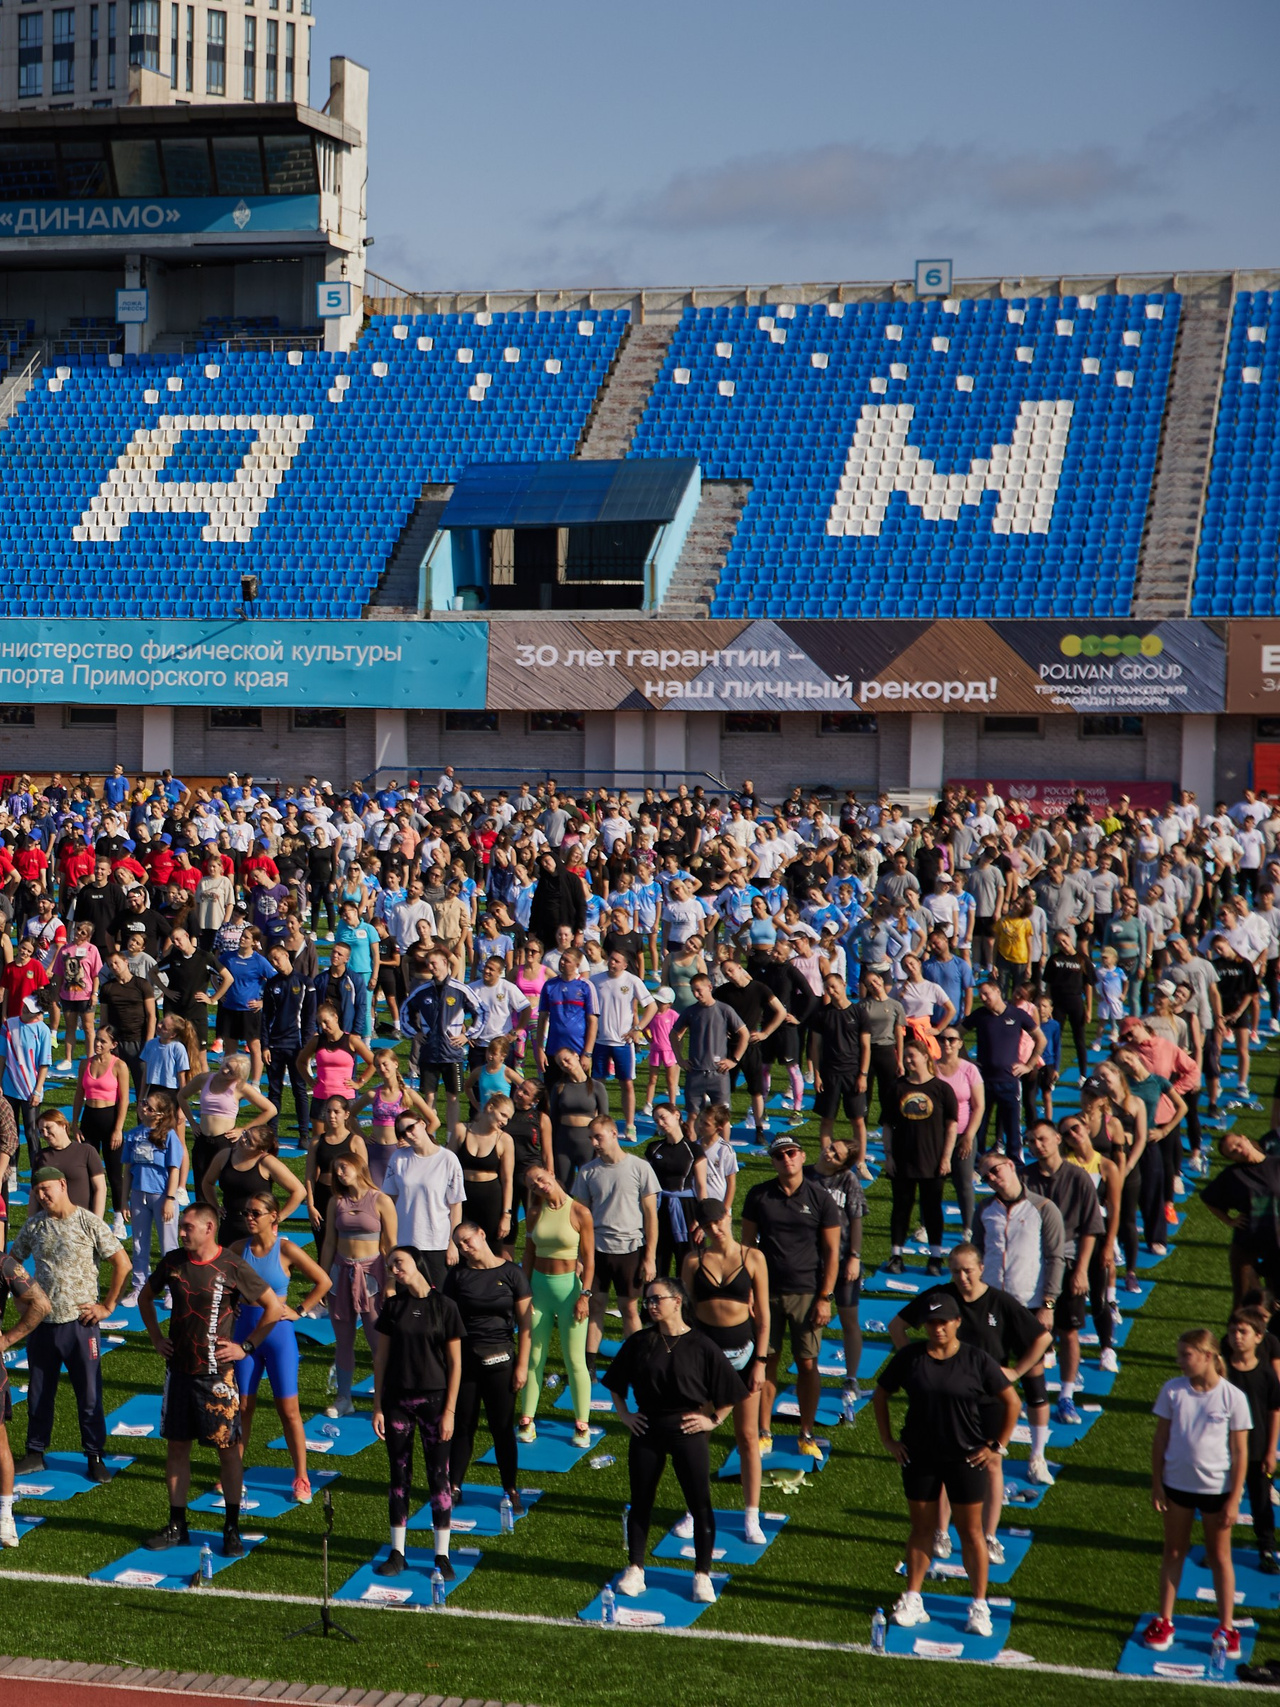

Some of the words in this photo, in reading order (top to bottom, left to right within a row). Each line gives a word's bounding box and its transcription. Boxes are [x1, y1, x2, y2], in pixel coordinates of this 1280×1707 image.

[925, 268, 942, 286] 6
[326, 291, 342, 308] 5
[140, 638, 284, 665] физической
[291, 644, 402, 667] культуры
[514, 645, 558, 667] 30
[563, 649, 621, 667] лет
[626, 649, 780, 671] гарантии
[72, 666, 227, 689] Приморского
[234, 669, 289, 690] края
[1039, 664, 1114, 680] POLIVAN
[1120, 664, 1183, 680] GROUP
[645, 680, 715, 698] наш
[720, 675, 852, 699] личный
[860, 677, 999, 703] рекорд!
[1035, 684, 1092, 695] ТЕРРАСЫ
[1098, 684, 1188, 695] ОГРАЖДЕНИЯ
[1051, 696, 1111, 706] ФАСАДЫ
[1116, 696, 1170, 706] ЗАБОРЫ
[208, 1283, 224, 1334] FIGHTING
[208, 1345, 218, 1375] PRIDE
